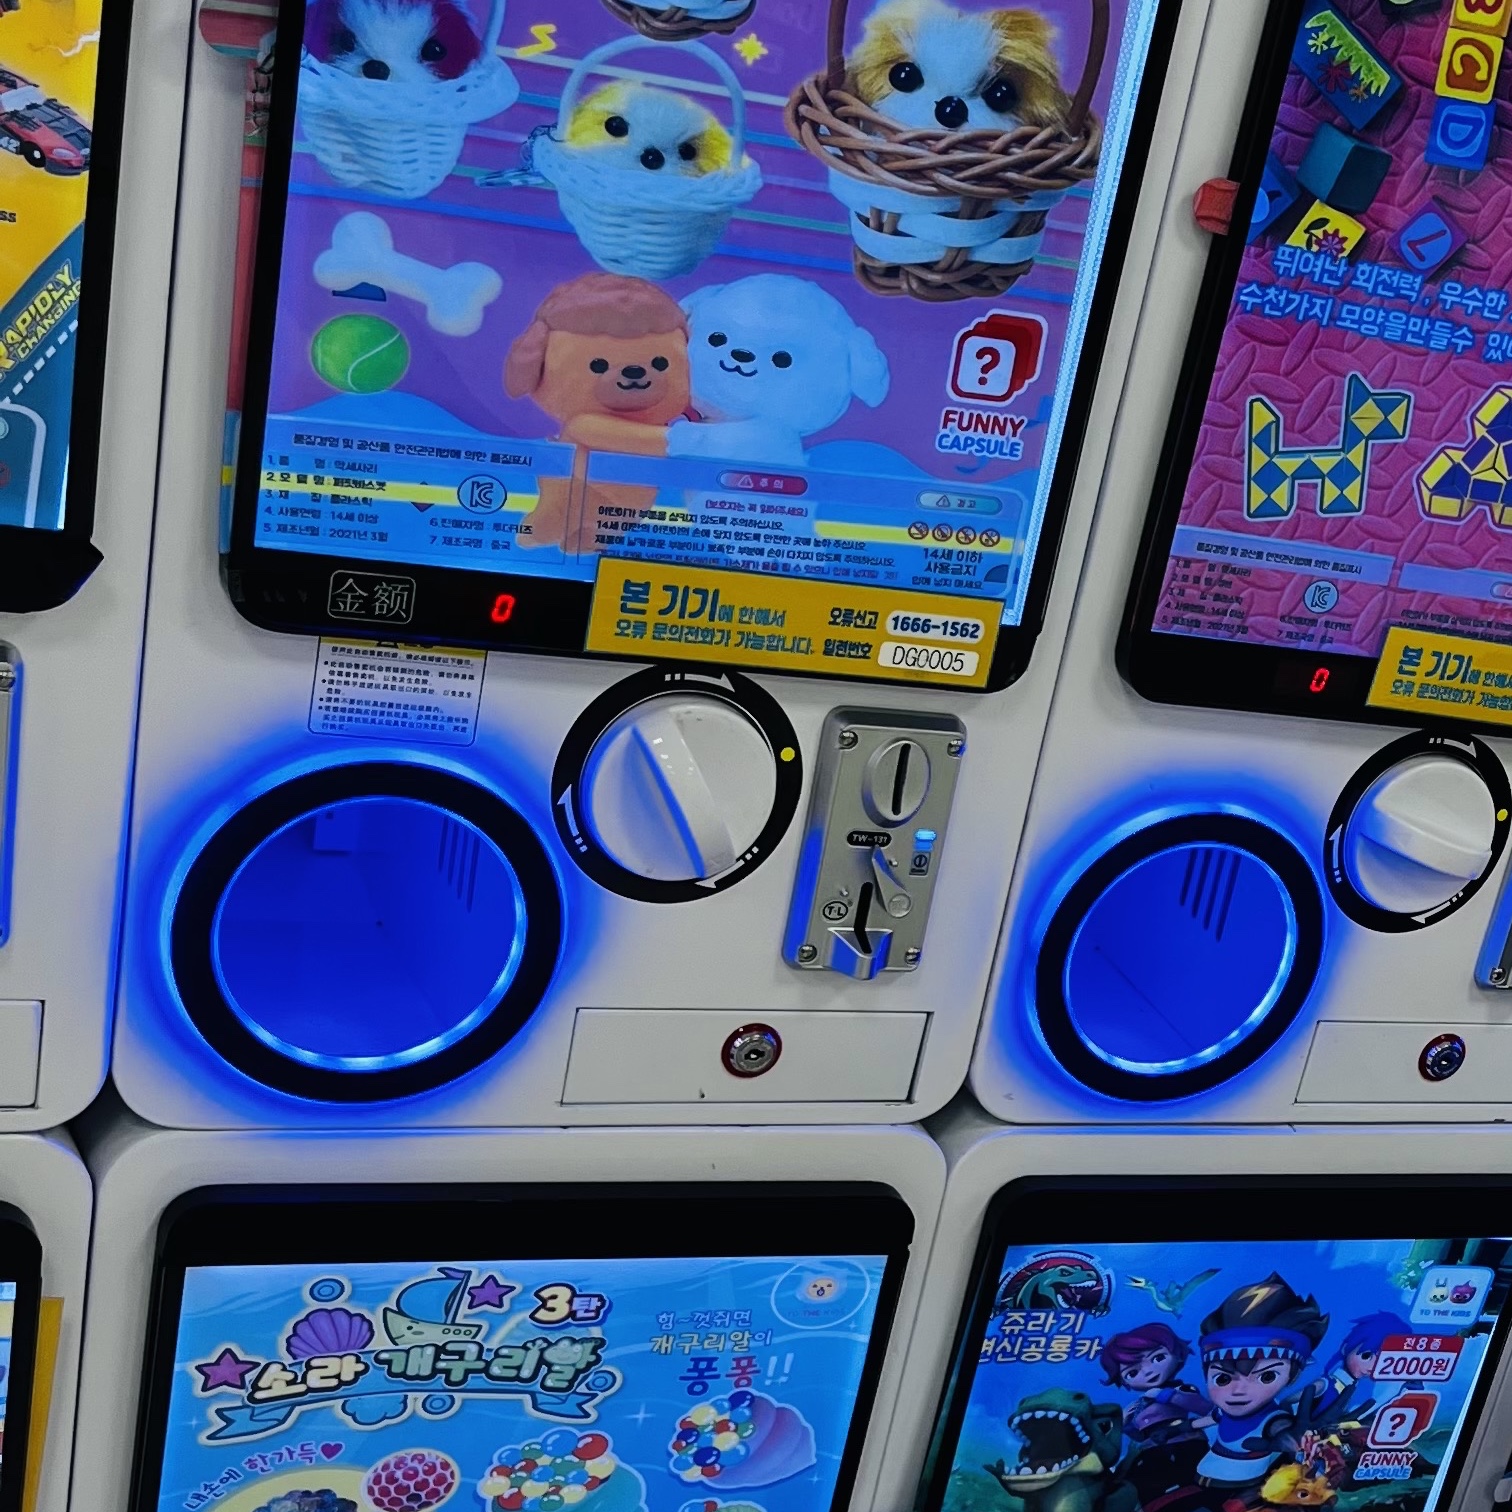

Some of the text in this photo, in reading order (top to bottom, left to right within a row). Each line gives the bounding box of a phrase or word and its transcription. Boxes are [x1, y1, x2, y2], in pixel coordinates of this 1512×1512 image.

[1239, 282, 1334, 327] 수천가지
[1439, 280, 1508, 321] 우수한
[941, 409, 1025, 438] FUNNY
[937, 433, 1021, 458] CAPSULE
[331, 577, 412, 619] 金额
[490, 593, 516, 624] 0
[620, 578, 652, 615] 본
[658, 584, 735, 623] 기기에
[614, 618, 648, 639] 오류
[828, 607, 981, 640] 오류신고 1666-1562
[892, 645, 966, 672] DG0005
[1397, 645, 1424, 676] 본
[1309, 667, 1330, 693] 0
[533, 1284, 603, 1323] 3탄
[1001, 1311, 1087, 1335] 쥬라기
[650, 1329, 773, 1357] 개구리알이
[251, 1339, 600, 1401] 소라 개구리알
[1378, 1356, 1450, 1377] 2000원
[1353, 1466, 1412, 1480] CAPSULE
[1360, 1451, 1419, 1467] FUNNY
[184, 1441, 318, 1512] 내손에 한가득
